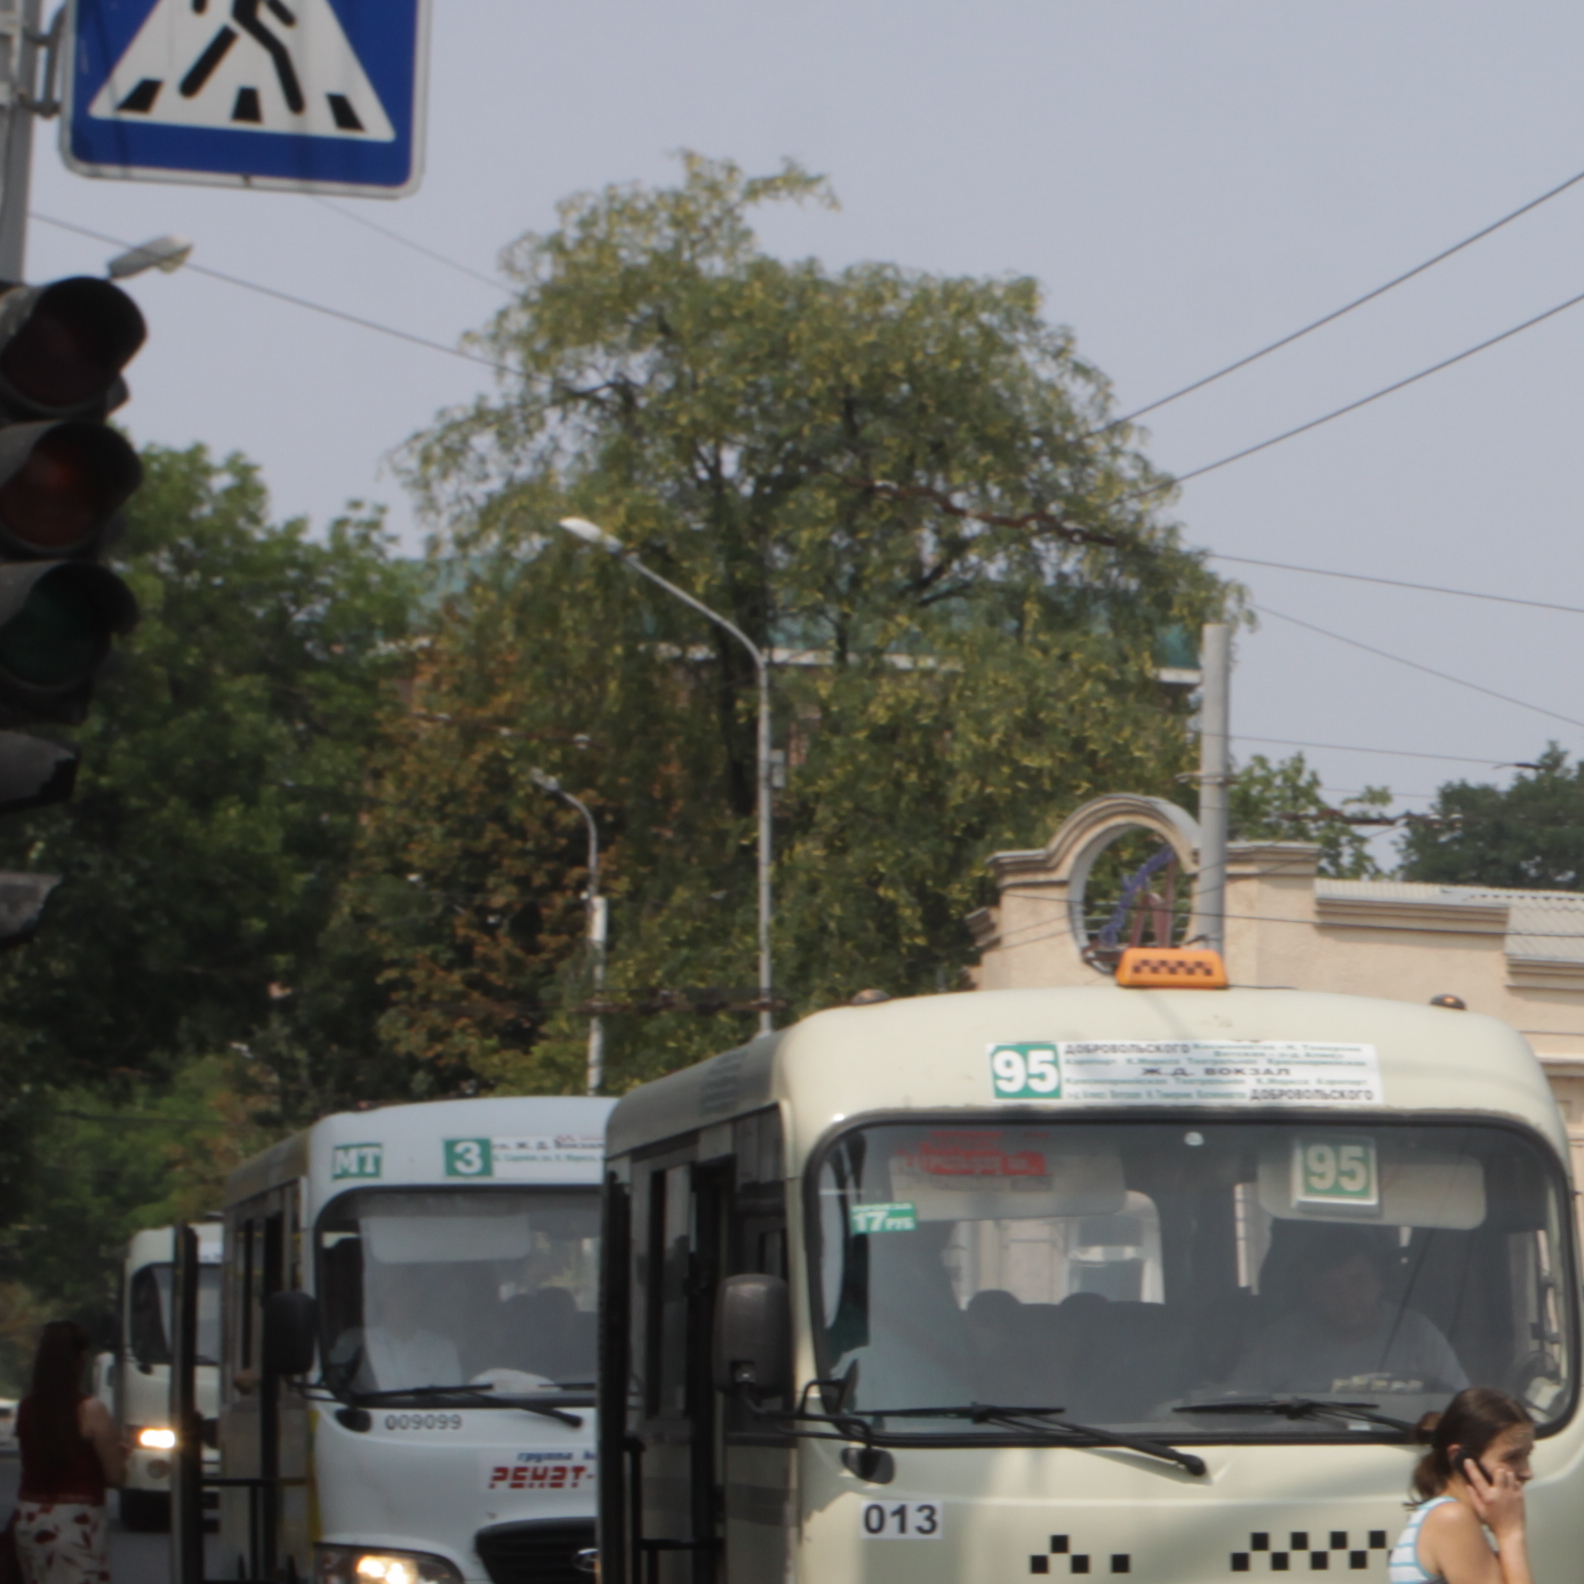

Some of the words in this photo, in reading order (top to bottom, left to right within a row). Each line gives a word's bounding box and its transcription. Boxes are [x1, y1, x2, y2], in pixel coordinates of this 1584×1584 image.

[1065, 1043, 1190, 1055] ДОБРОВОЛЬСКОГО
[992, 1048, 1060, 1093] 95
[1204, 1067, 1291, 1076] ВОКЗАЛ
[1250, 1088, 1375, 1101] ДОБРОВОЛЬСКОГО
[334, 1146, 382, 1176] МТ
[452, 1141, 484, 1175] 3
[1306, 1143, 1367, 1192] 95
[852, 1211, 887, 1231] 17
[384, 1414, 463, 1431] 009099
[864, 1503, 938, 1535] 013
